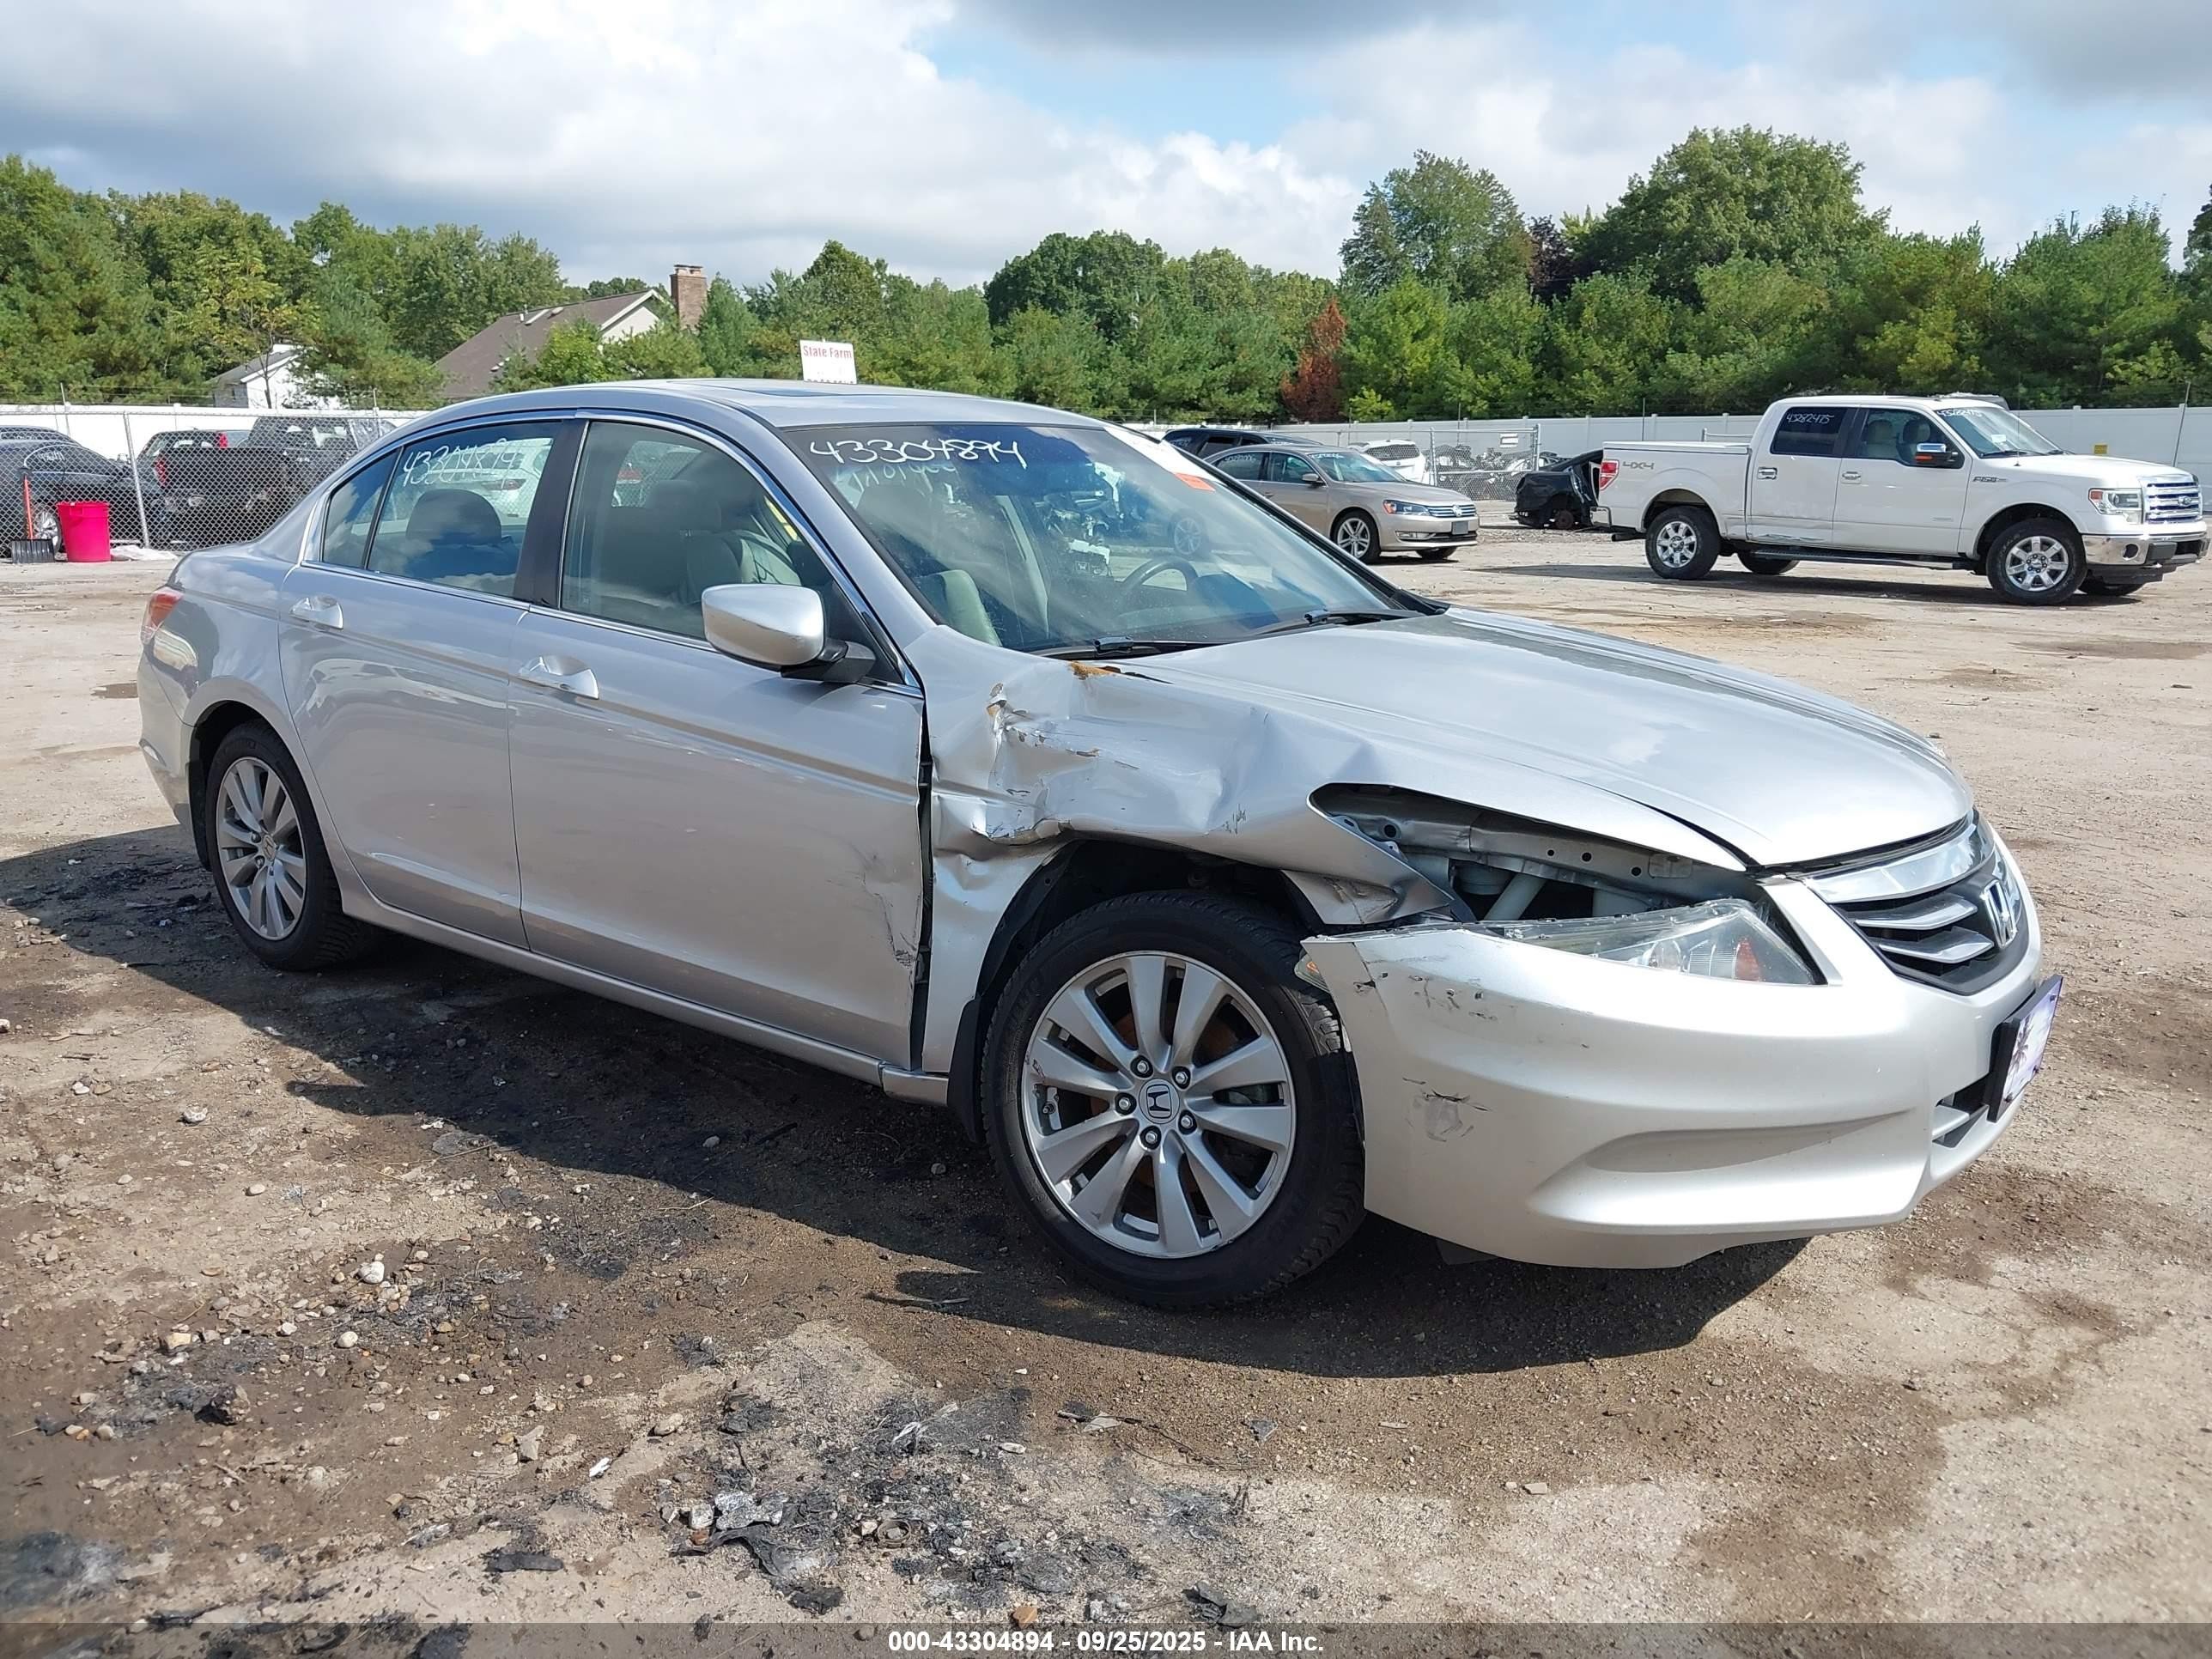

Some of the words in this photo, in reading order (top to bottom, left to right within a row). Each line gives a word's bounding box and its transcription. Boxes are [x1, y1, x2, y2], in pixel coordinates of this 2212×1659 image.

[803, 345, 827, 357] State
[830, 348, 853, 359] Farm
[810, 439, 1028, 470] 43304894
